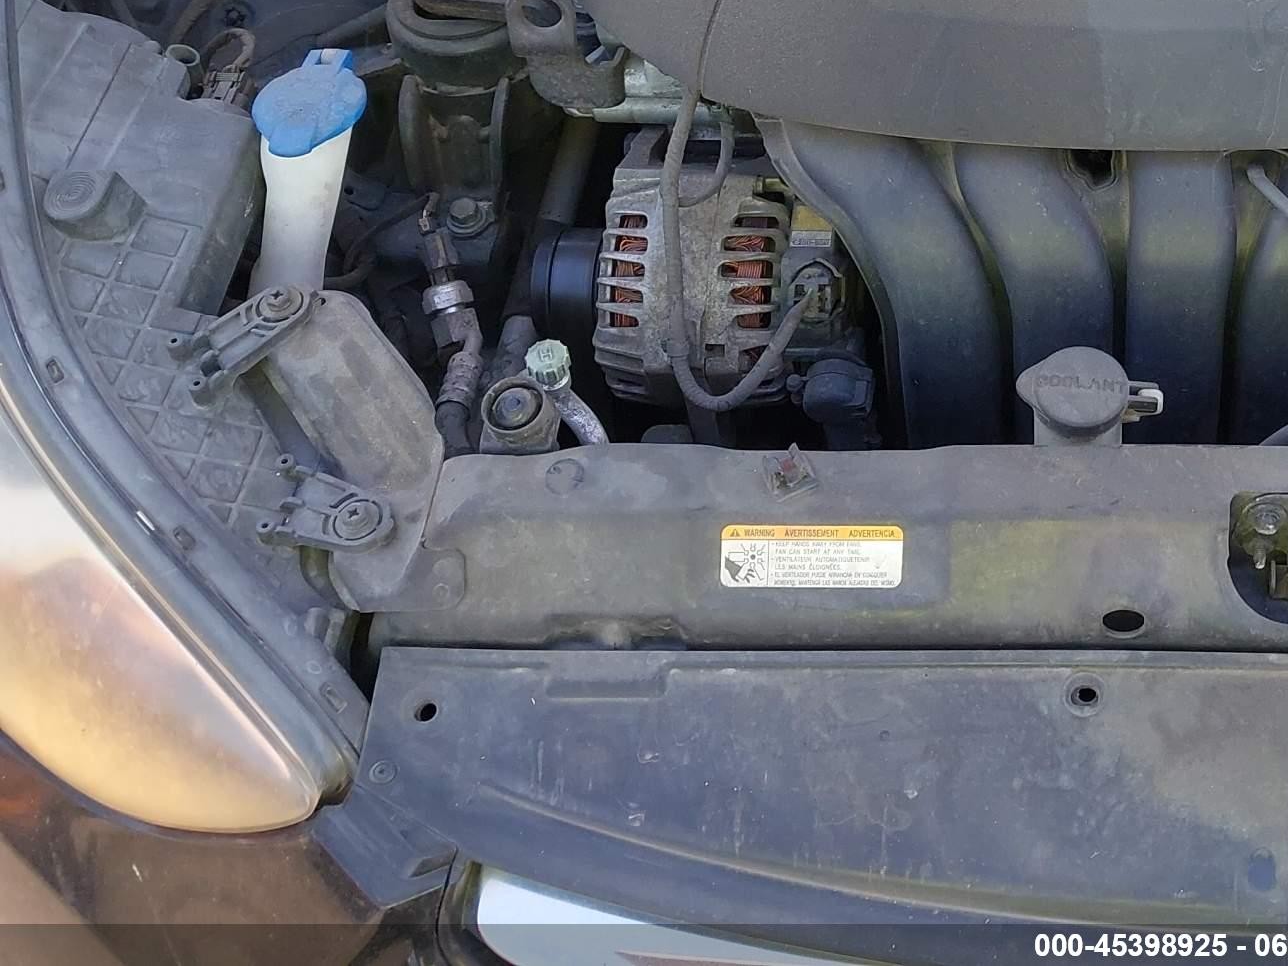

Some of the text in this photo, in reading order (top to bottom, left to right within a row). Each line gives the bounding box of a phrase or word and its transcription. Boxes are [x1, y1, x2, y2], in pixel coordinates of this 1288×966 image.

[1036, 374, 1124, 395] COOLANT
[744, 528, 895, 538] WARNING AVERTISSEMENT ADVERTENCIA
